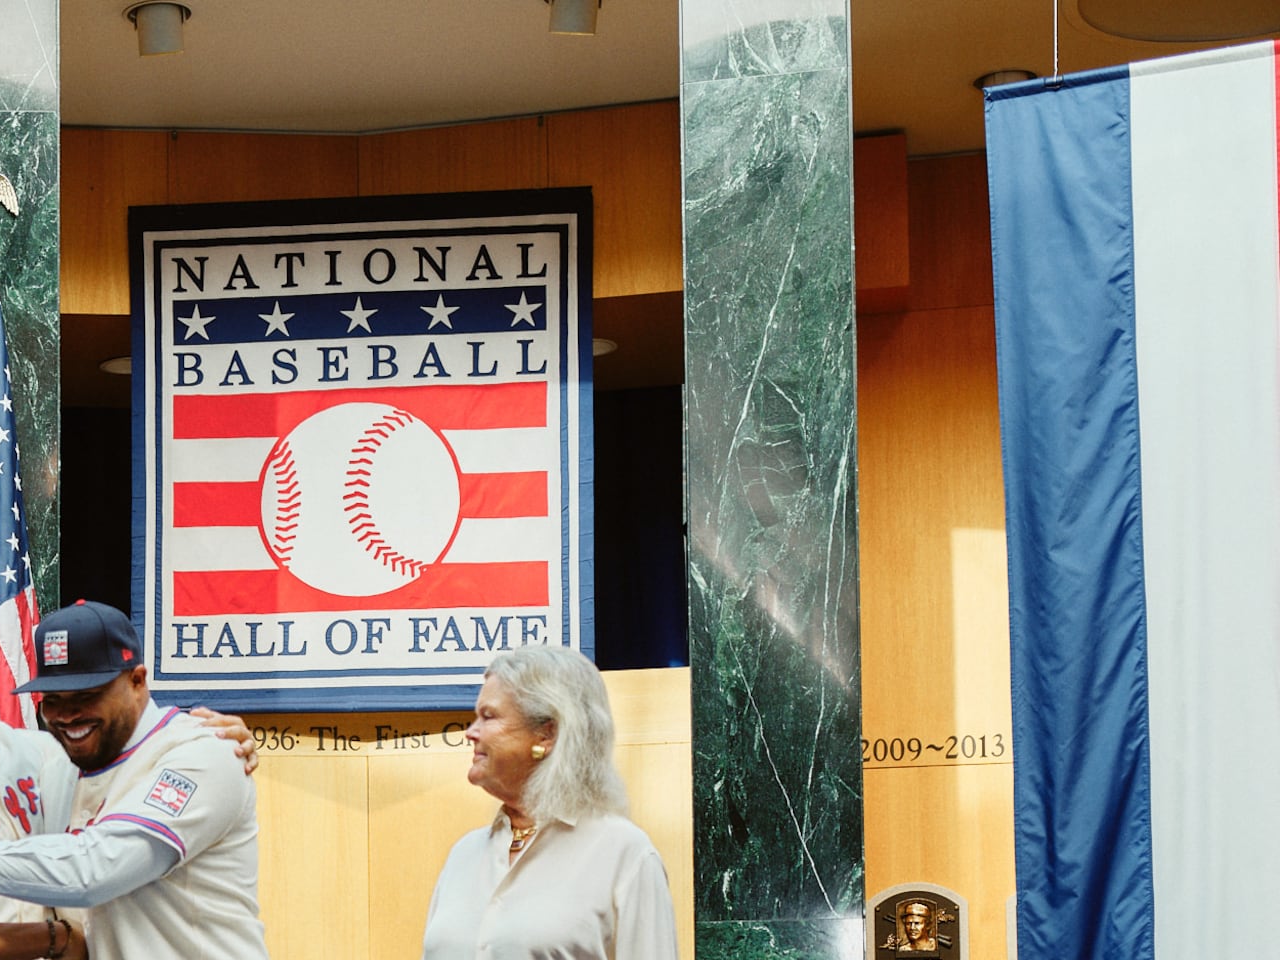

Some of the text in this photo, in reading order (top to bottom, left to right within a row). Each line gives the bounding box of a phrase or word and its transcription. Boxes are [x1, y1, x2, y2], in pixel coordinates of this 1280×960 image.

[172, 243, 547, 293] NATIONAL
[173, 339, 547, 387] BASEBALL
[171, 614, 549, 659] HALL OF FAME
[249, 726, 300, 751] 936:
[310, 726, 361, 752] The
[375, 723, 431, 750] First
